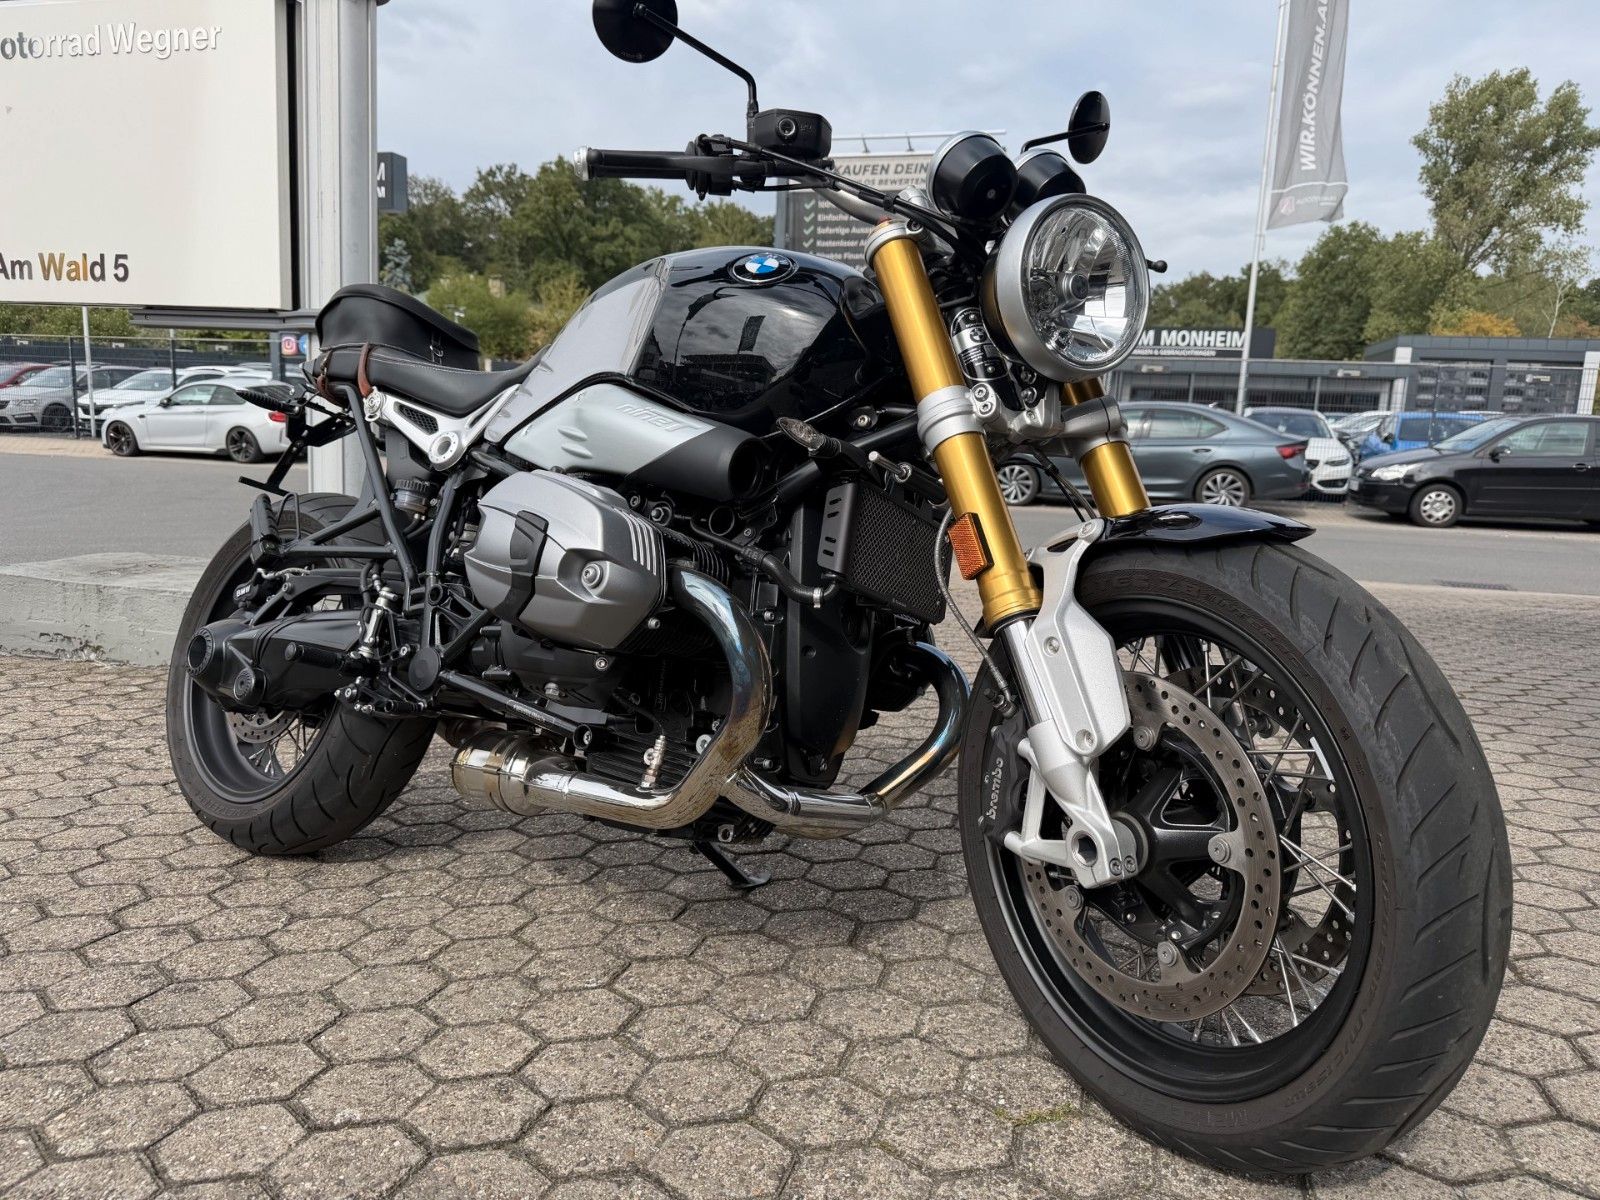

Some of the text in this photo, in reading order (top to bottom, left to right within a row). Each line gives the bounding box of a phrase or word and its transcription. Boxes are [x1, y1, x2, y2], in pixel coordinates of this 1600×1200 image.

[106, 21, 222, 60] Wegner
[894, 163, 929, 175] DEIN
[878, 178, 927, 186] BEWERTEN
[38, 252, 106, 282] Wald
[113, 253, 130, 282] 5
[1160, 329, 1245, 347] MONHEIM
[983, 757, 1004, 821] brembo
